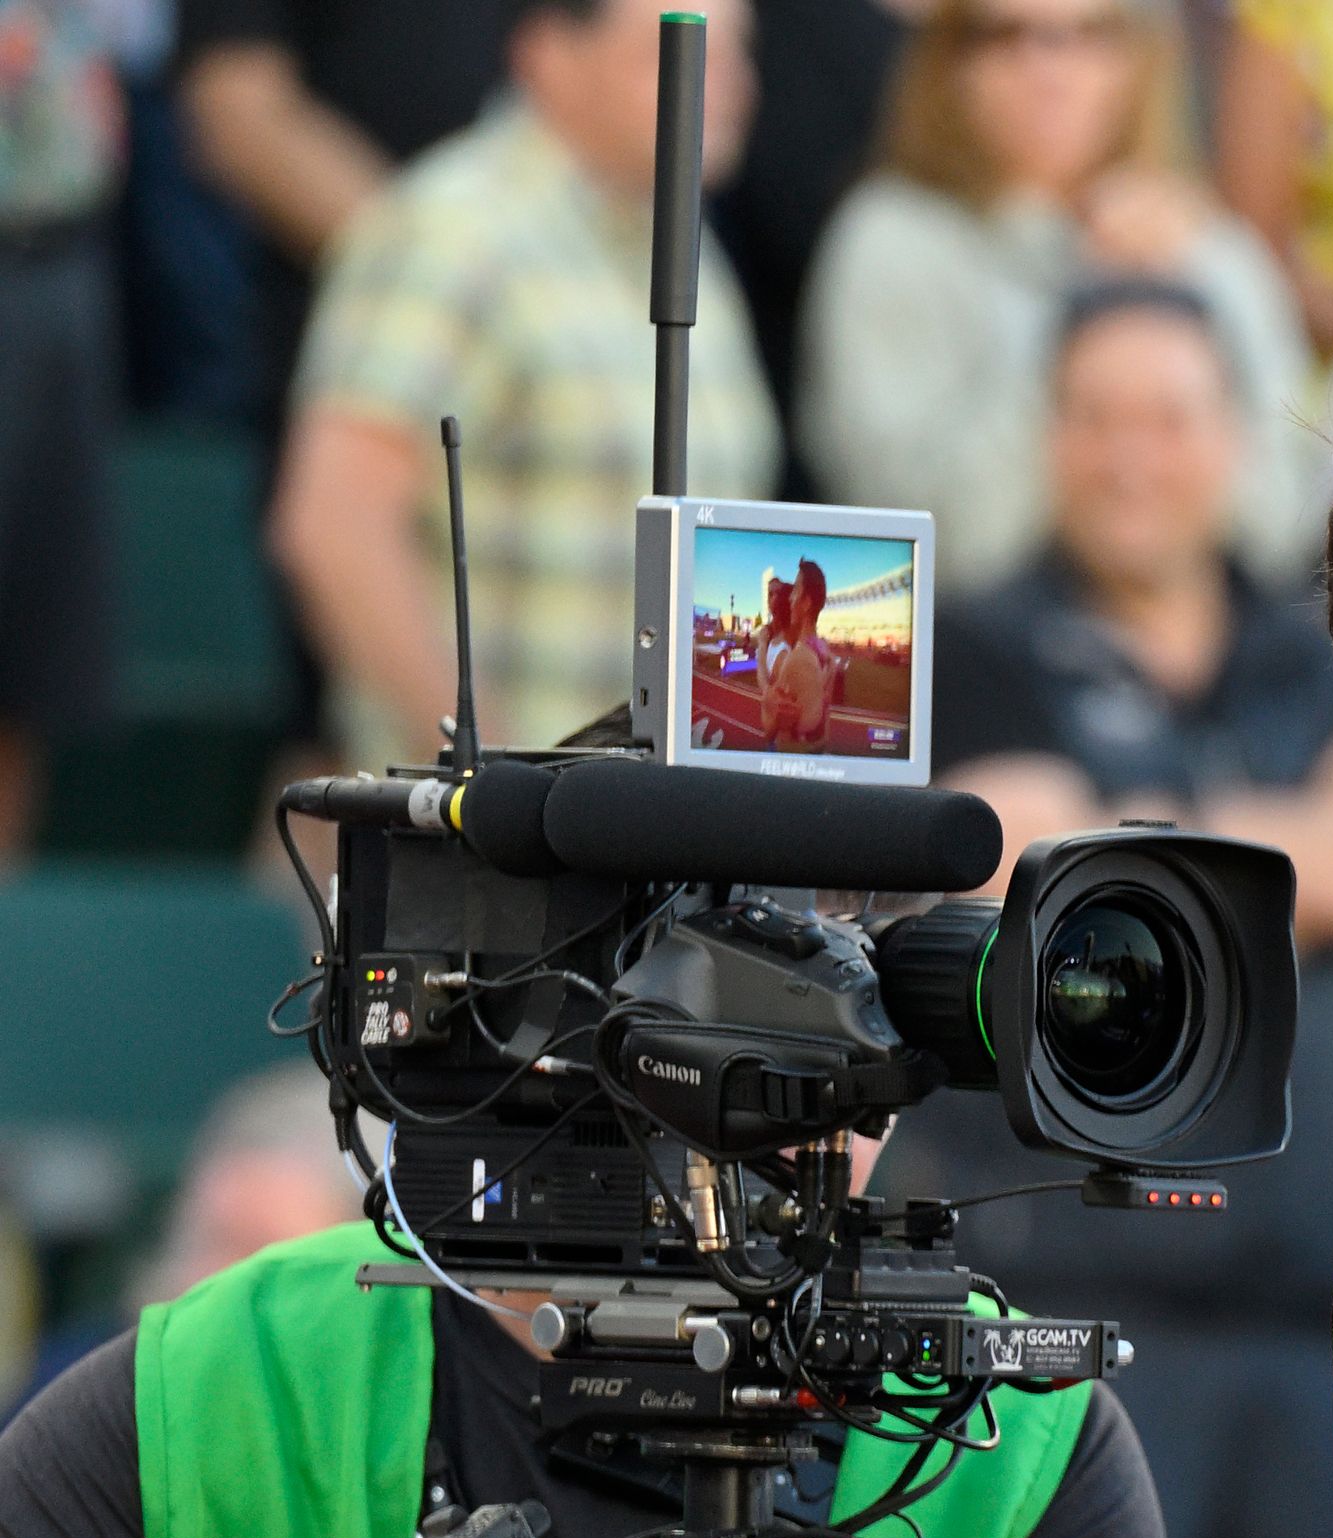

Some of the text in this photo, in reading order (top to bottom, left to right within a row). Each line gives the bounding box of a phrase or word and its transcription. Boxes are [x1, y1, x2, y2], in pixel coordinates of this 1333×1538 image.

[696, 504, 714, 525] 4K
[638, 1054, 701, 1086] Canon
[1026, 1328, 1092, 1347] GCAM.TV
[569, 1376, 625, 1397] PRO
